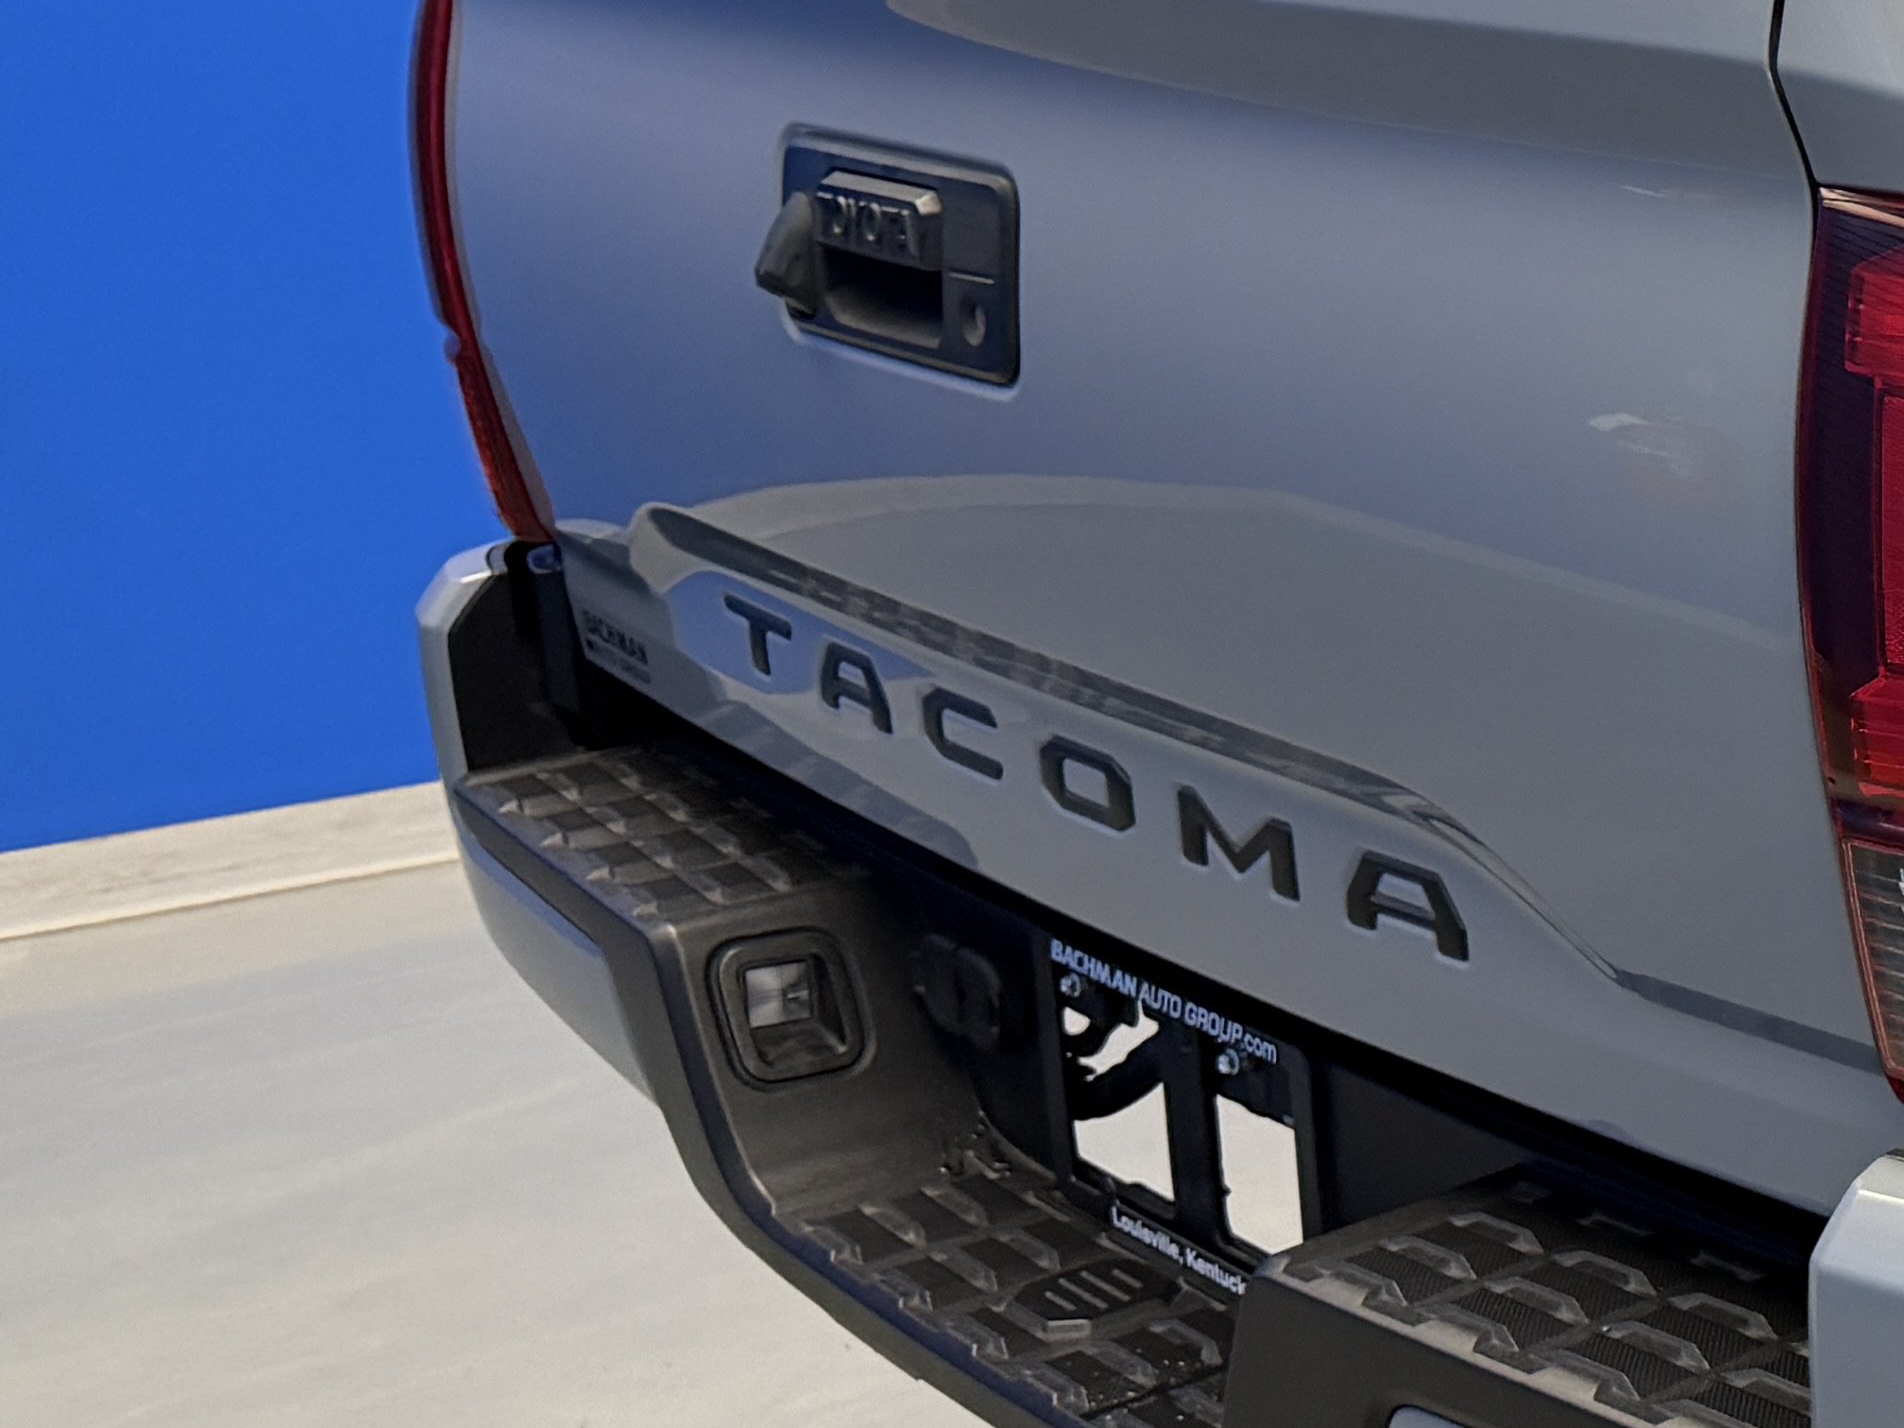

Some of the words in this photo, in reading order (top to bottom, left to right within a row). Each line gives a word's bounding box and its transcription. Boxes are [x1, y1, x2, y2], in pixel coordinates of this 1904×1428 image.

[723, 594, 1470, 963] TACOMA
[1050, 939, 1138, 999] BACHMAN
[1138, 981, 1183, 1019] AUTO
[1184, 1003, 1278, 1064] GROUP.com
[1110, 1205, 1183, 1265] Louisville,
[1185, 1248, 1247, 1296] Kentuck
